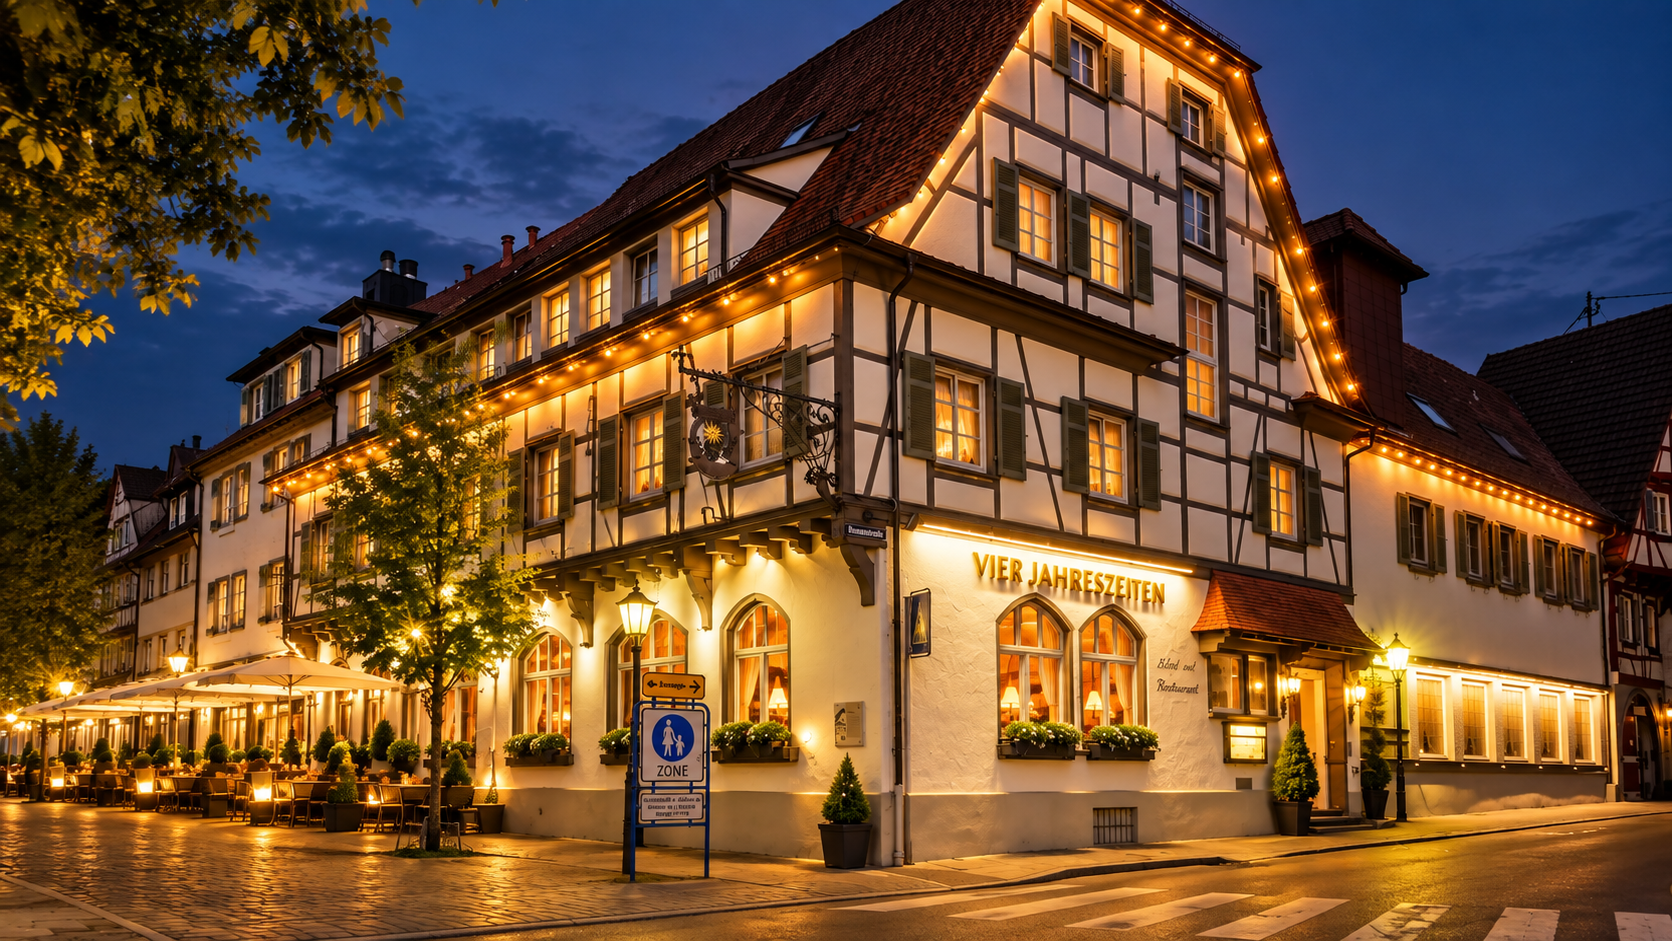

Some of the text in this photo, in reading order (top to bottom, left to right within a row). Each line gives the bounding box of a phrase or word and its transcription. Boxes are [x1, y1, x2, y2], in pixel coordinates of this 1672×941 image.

[972, 552, 1165, 604] VIER JAHRESZEITEN
[656, 764, 689, 777] ZONE
